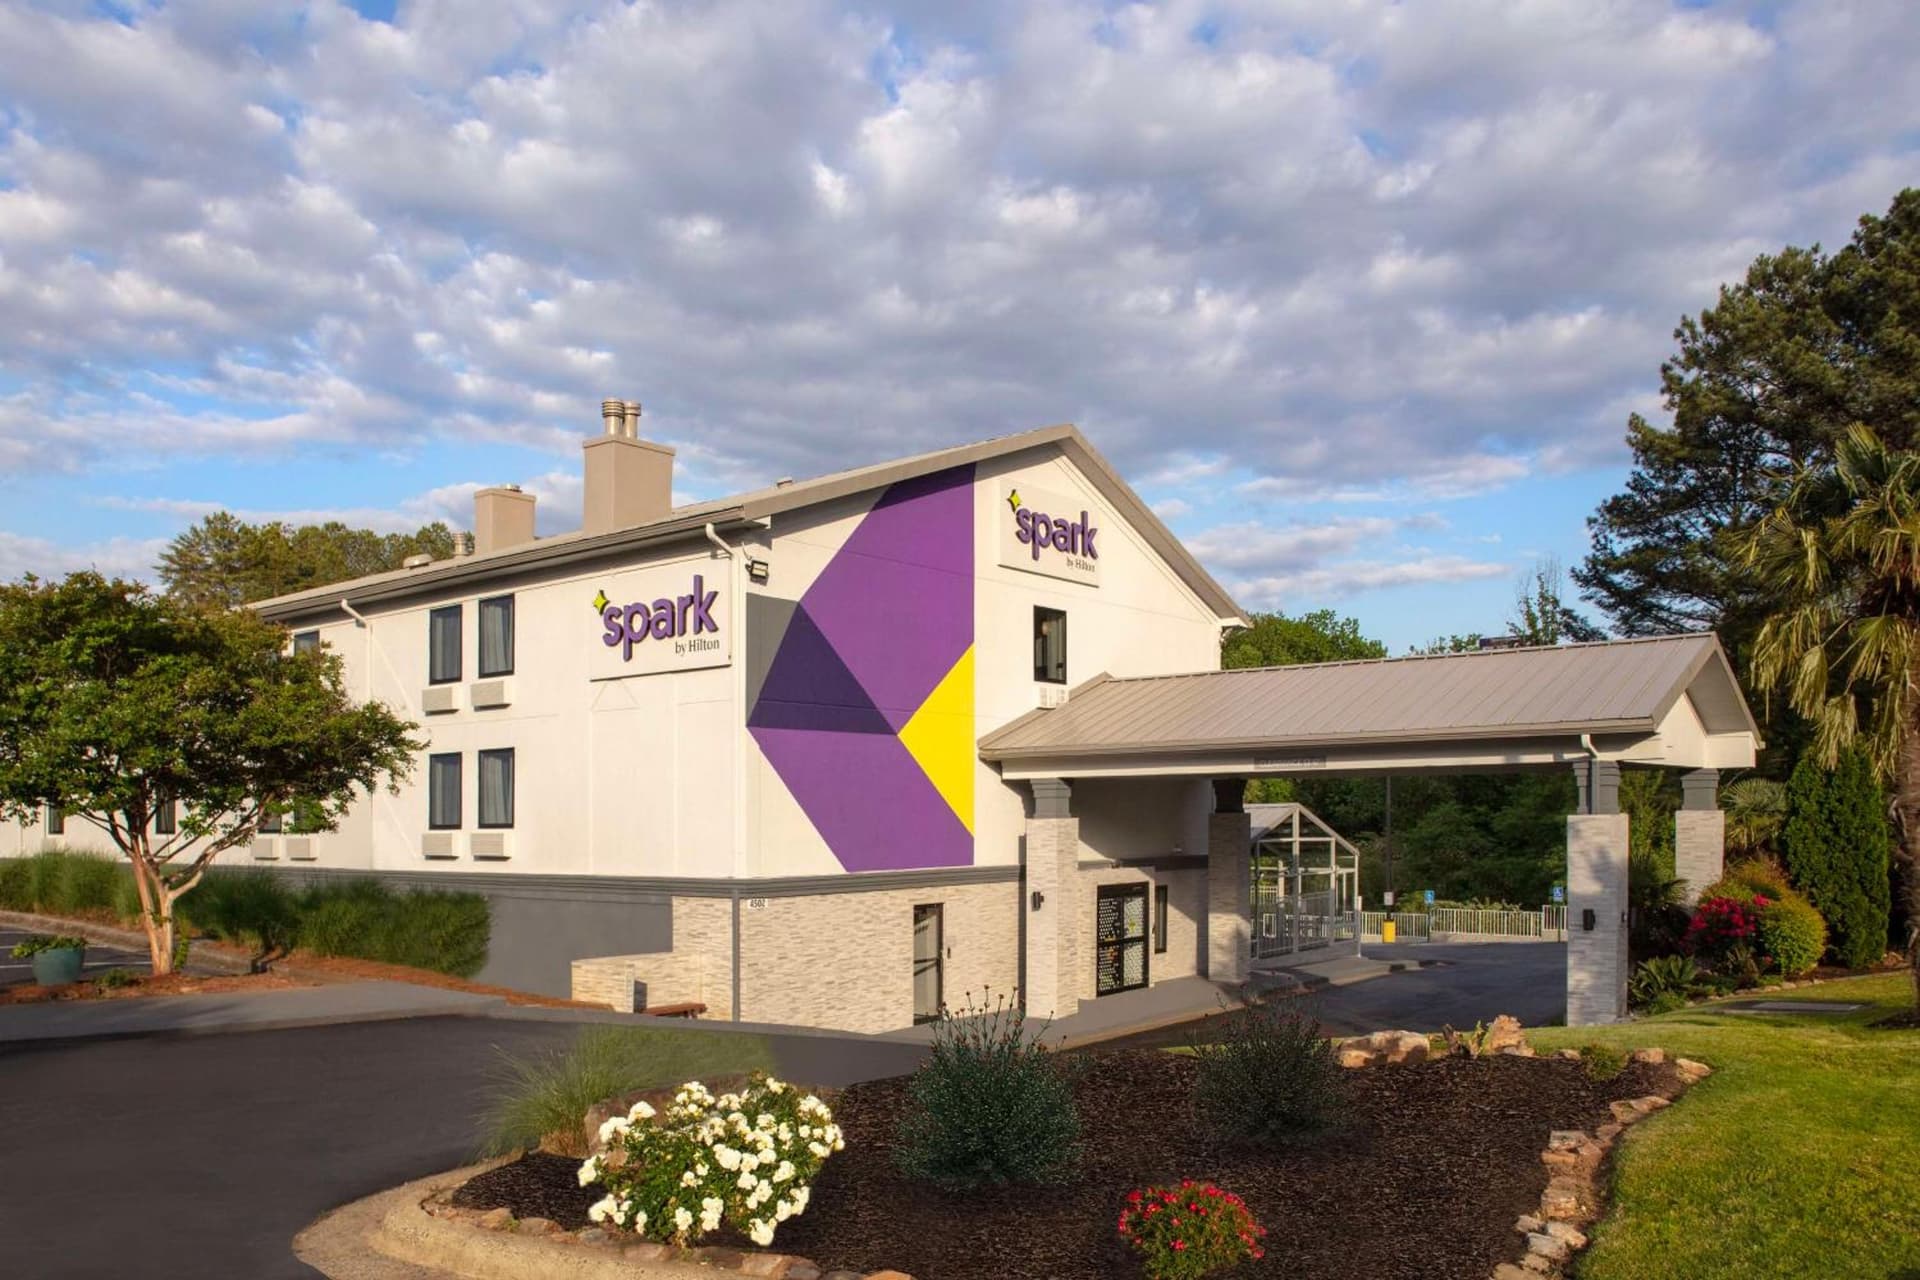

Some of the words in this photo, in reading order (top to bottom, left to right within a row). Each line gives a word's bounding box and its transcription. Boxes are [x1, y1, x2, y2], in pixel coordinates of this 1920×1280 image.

[1015, 508, 1098, 561] spark
[602, 574, 719, 662] spark
[675, 640, 686, 657] by
[688, 638, 720, 652] Hilton
